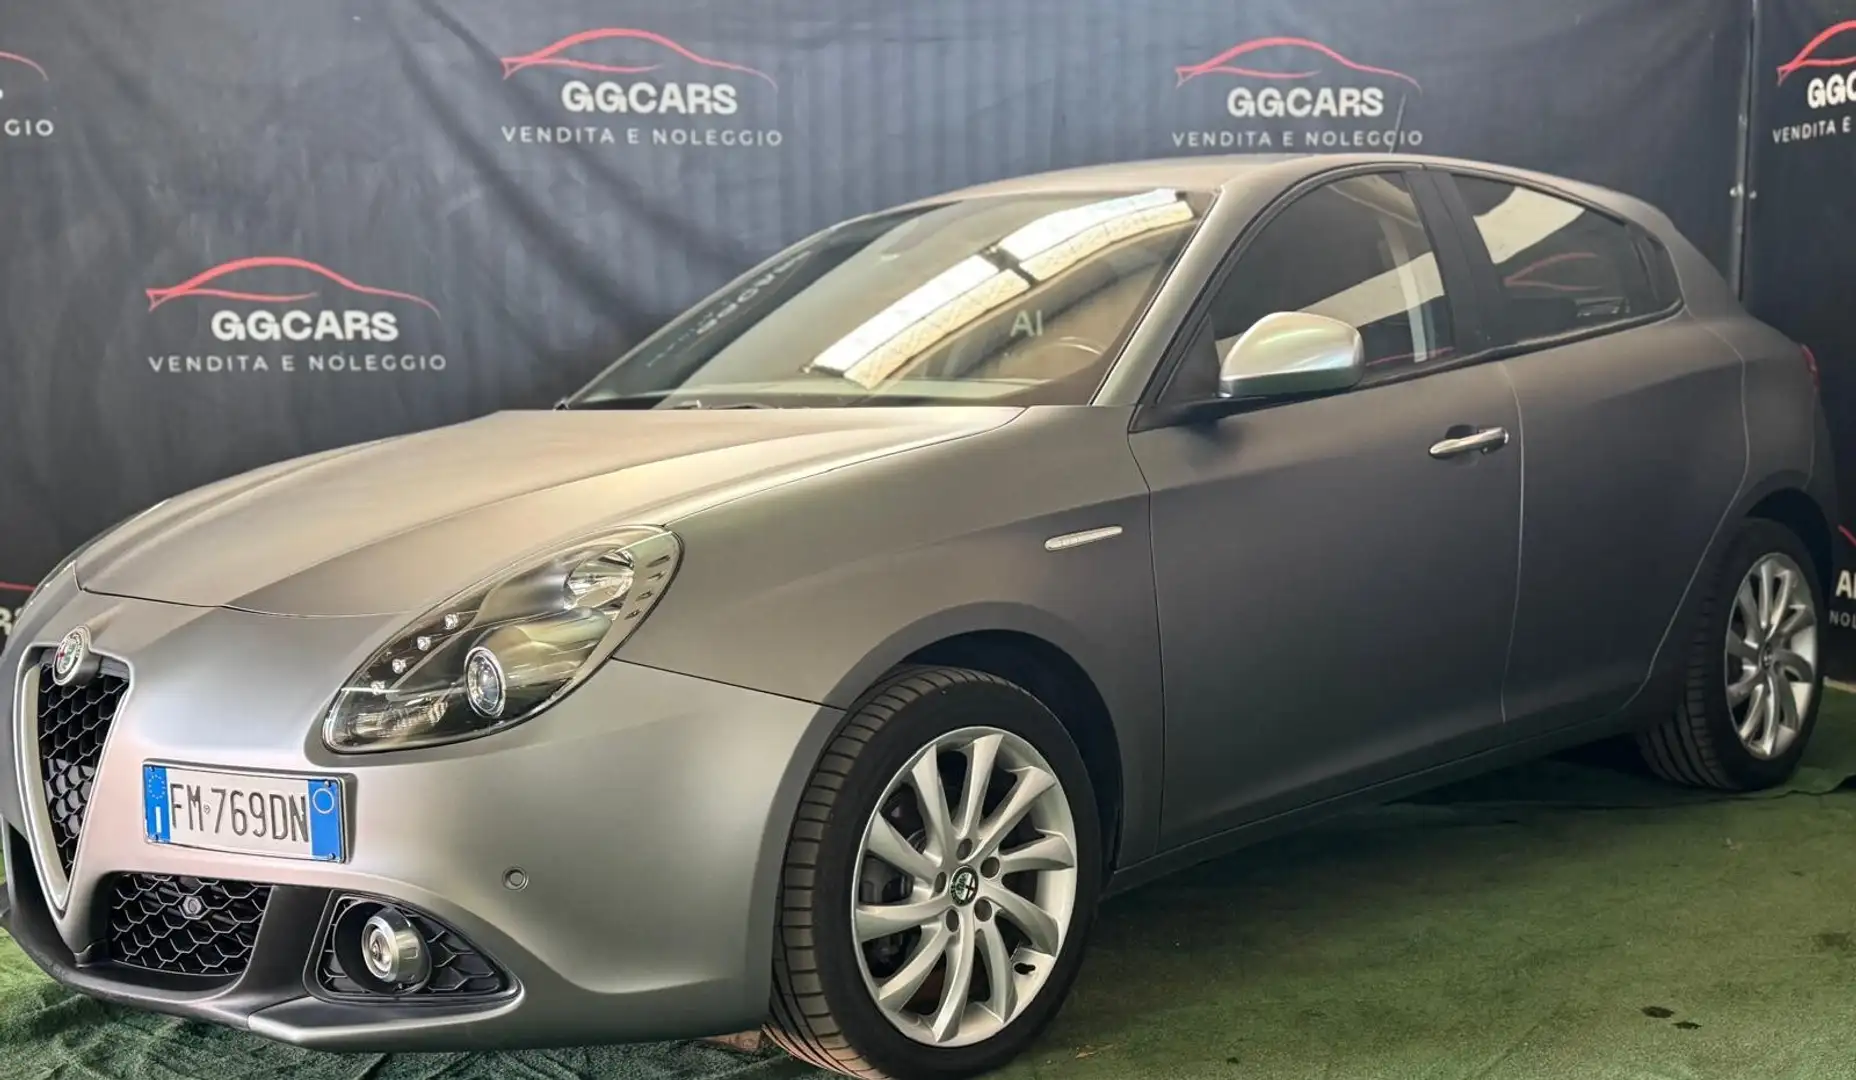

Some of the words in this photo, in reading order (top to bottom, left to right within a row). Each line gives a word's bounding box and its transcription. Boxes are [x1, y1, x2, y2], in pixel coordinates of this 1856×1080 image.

[561, 80, 738, 115] GGCARS
[1227, 87, 1384, 118] GGCARS
[501, 125, 615, 145] VENDITA
[628, 128, 640, 144] E
[652, 128, 783, 147] NOLEGGIO
[1172, 131, 1272, 147] VENDITA
[1283, 131, 1294, 146] E
[1305, 130, 1423, 146] NOLEGGIO
[1772, 119, 1836, 144] VENDITA
[1842, 116, 1852, 133] E
[211, 309, 399, 342] GGCARS
[1010, 309, 1043, 337] AI
[148, 355, 268, 373] VENDITA
[283, 356, 295, 372] E
[309, 354, 447, 372] NOLEGGIO
[1835, 569, 1856, 600] A
